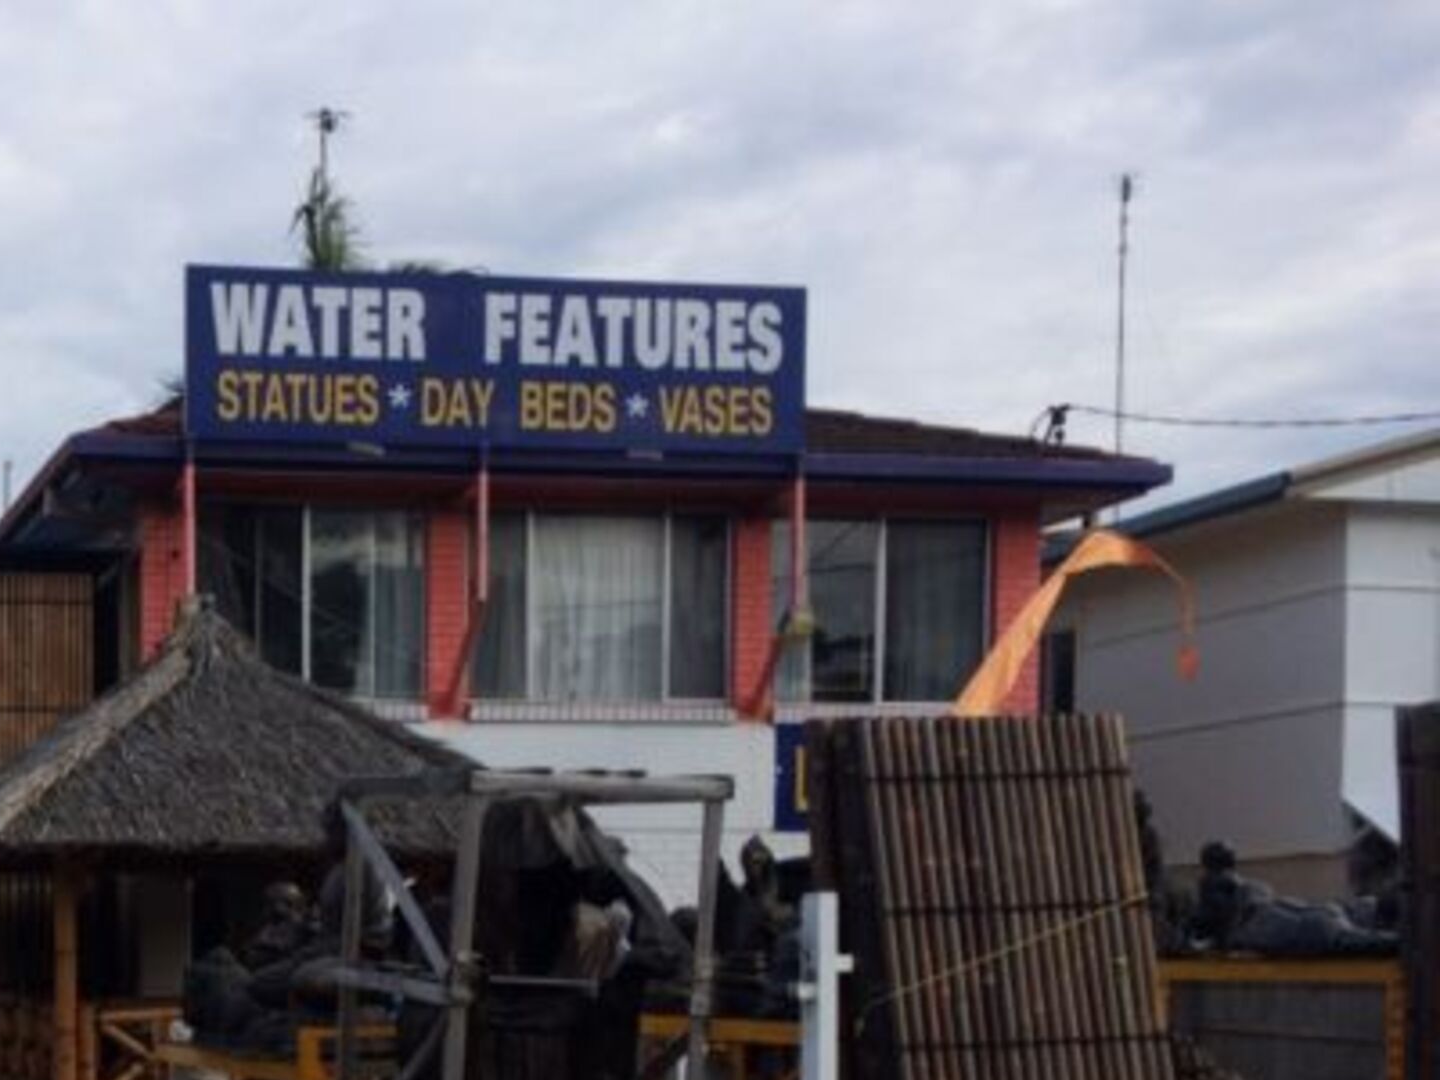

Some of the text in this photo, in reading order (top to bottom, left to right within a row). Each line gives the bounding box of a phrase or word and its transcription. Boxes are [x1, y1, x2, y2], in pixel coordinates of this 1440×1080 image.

[211, 282, 783, 374] WATER FEATURES
[217, 370, 773, 435] STATUES DAY BEDS VASES
